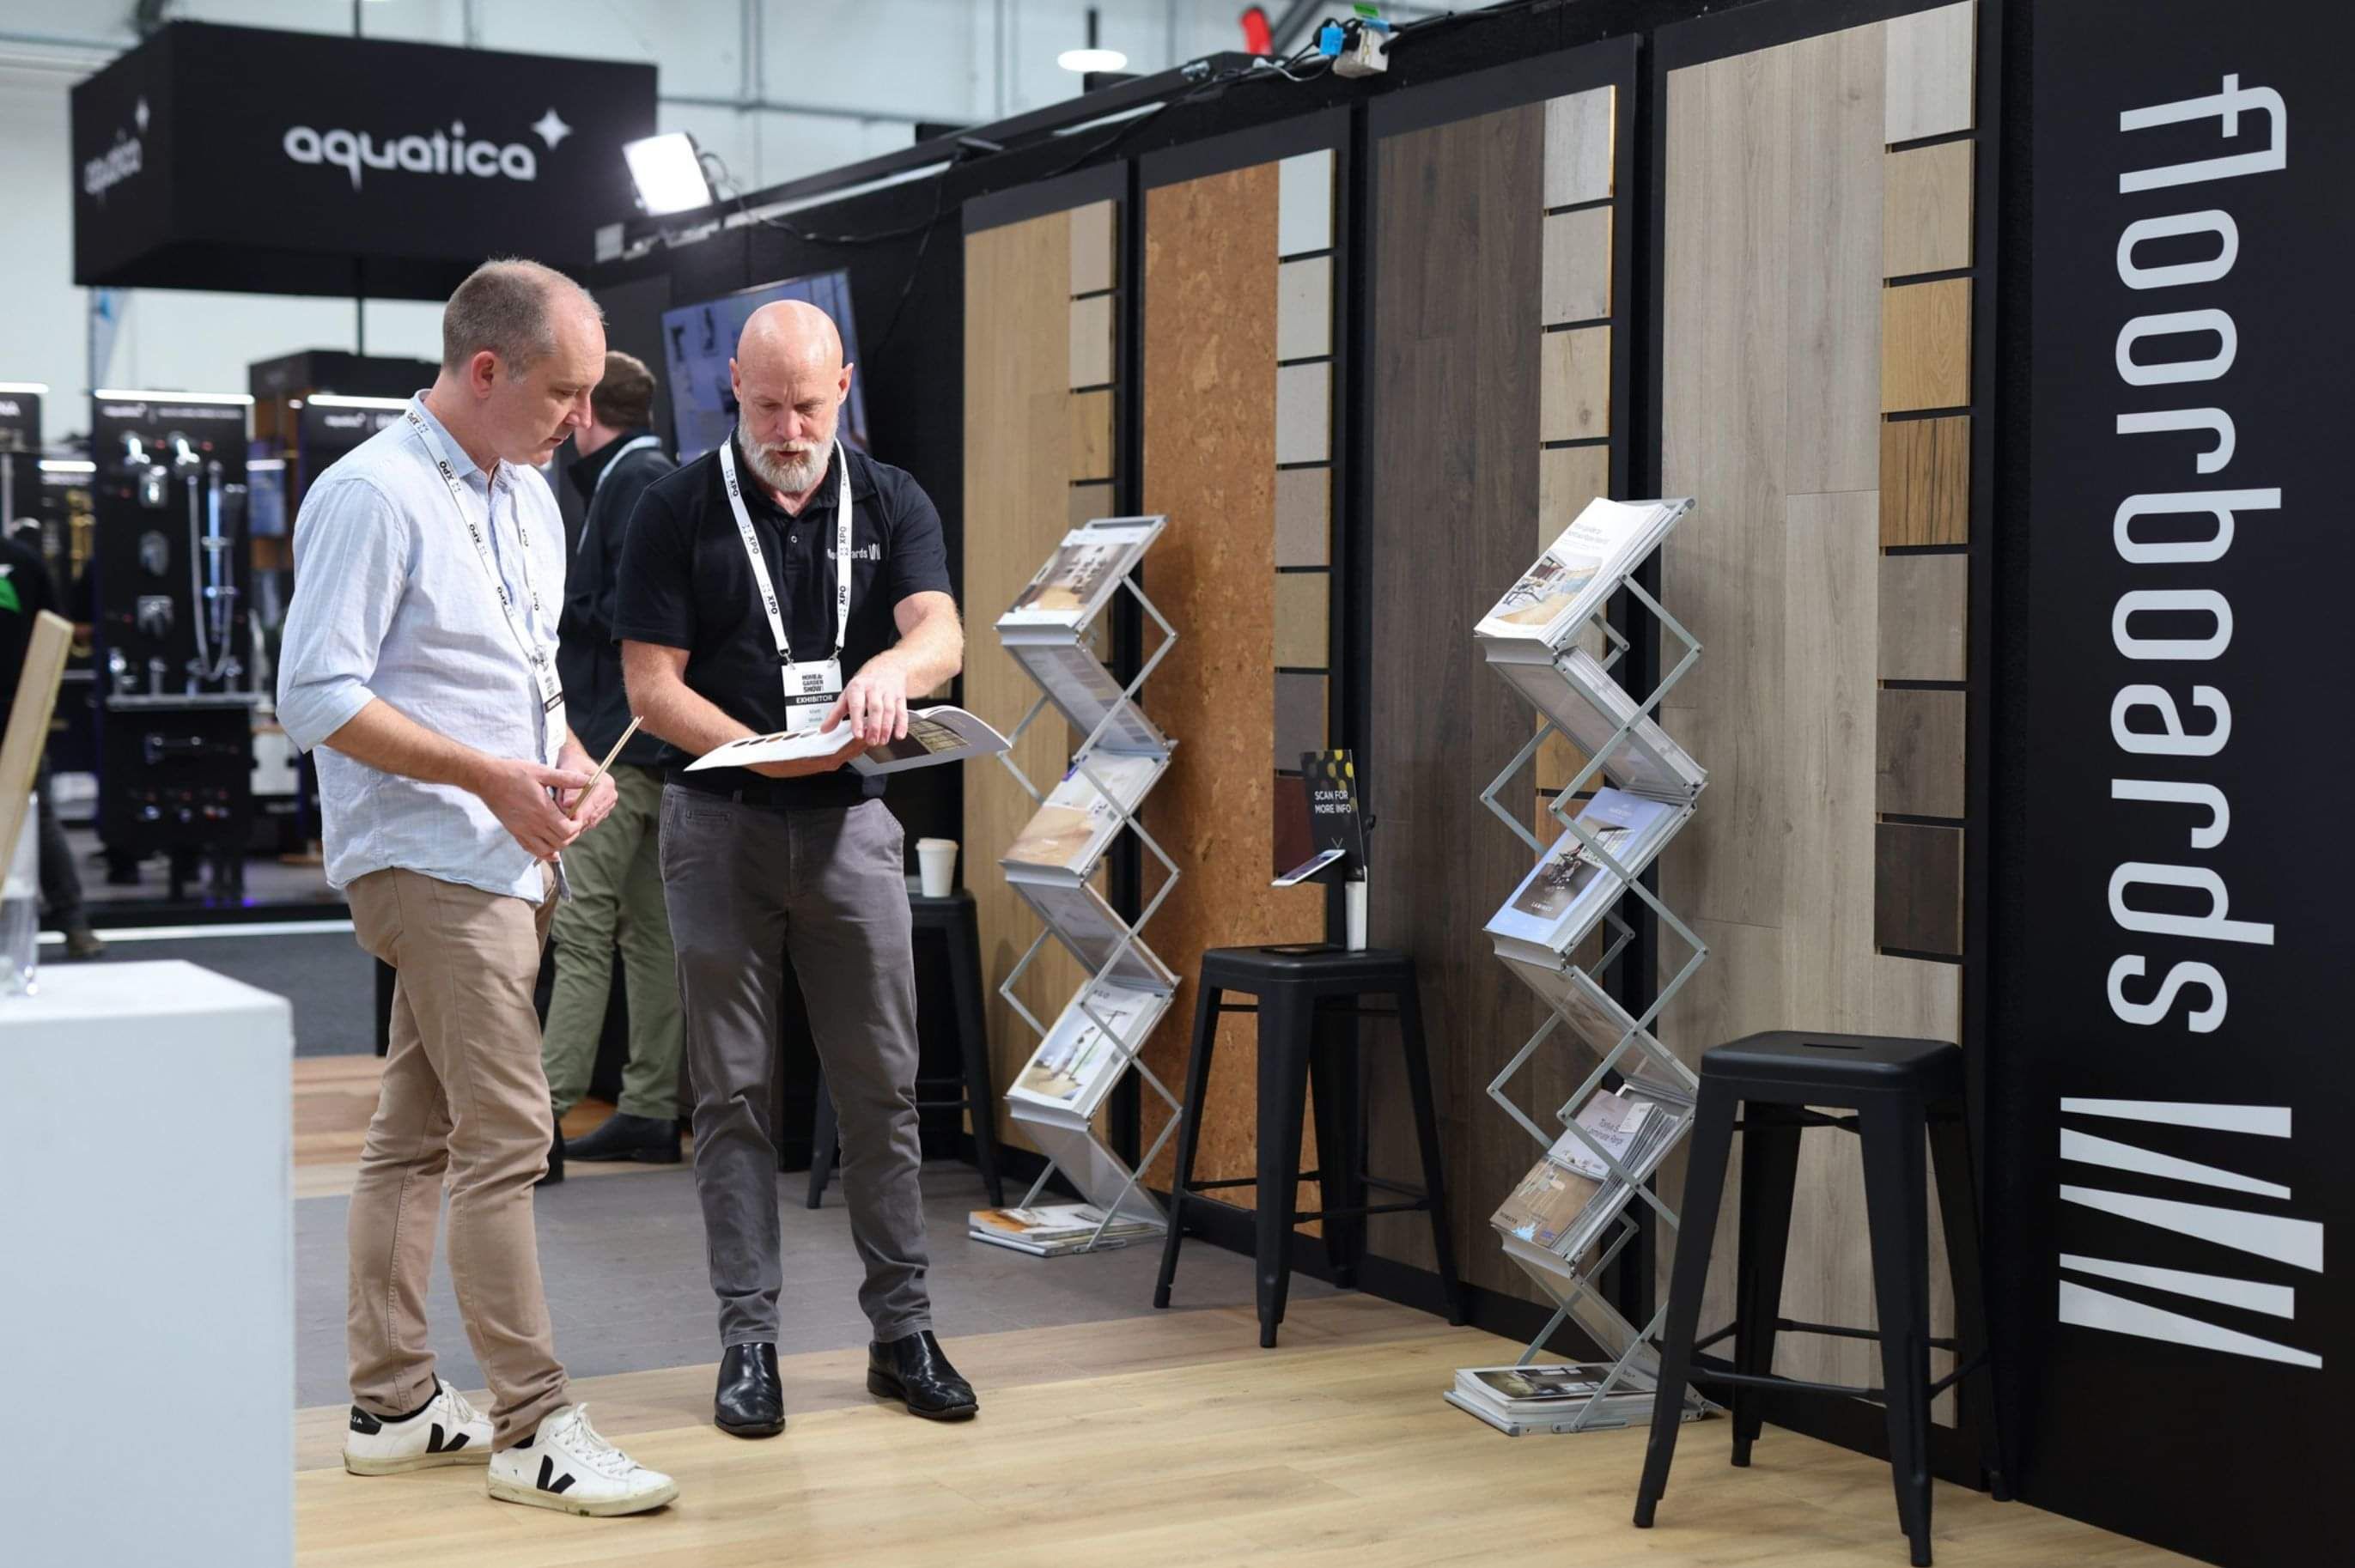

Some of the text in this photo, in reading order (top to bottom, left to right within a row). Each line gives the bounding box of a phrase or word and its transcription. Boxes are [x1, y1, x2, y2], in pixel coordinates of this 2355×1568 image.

[283, 119, 537, 191] aquatica
[439, 460, 454, 481] XPO
[730, 480, 739, 497] XPO
[838, 526, 847, 544] XPO
[748, 536, 759, 555] XPO
[2107, 73, 2287, 1034] floorboards
[767, 594, 778, 615] XPO
[838, 585, 847, 605] XPO
[795, 694, 833, 704] EXHIBITOR
[1314, 790, 1348, 800] SCAN FOR
[1314, 804, 1352, 814] MORE INFO
